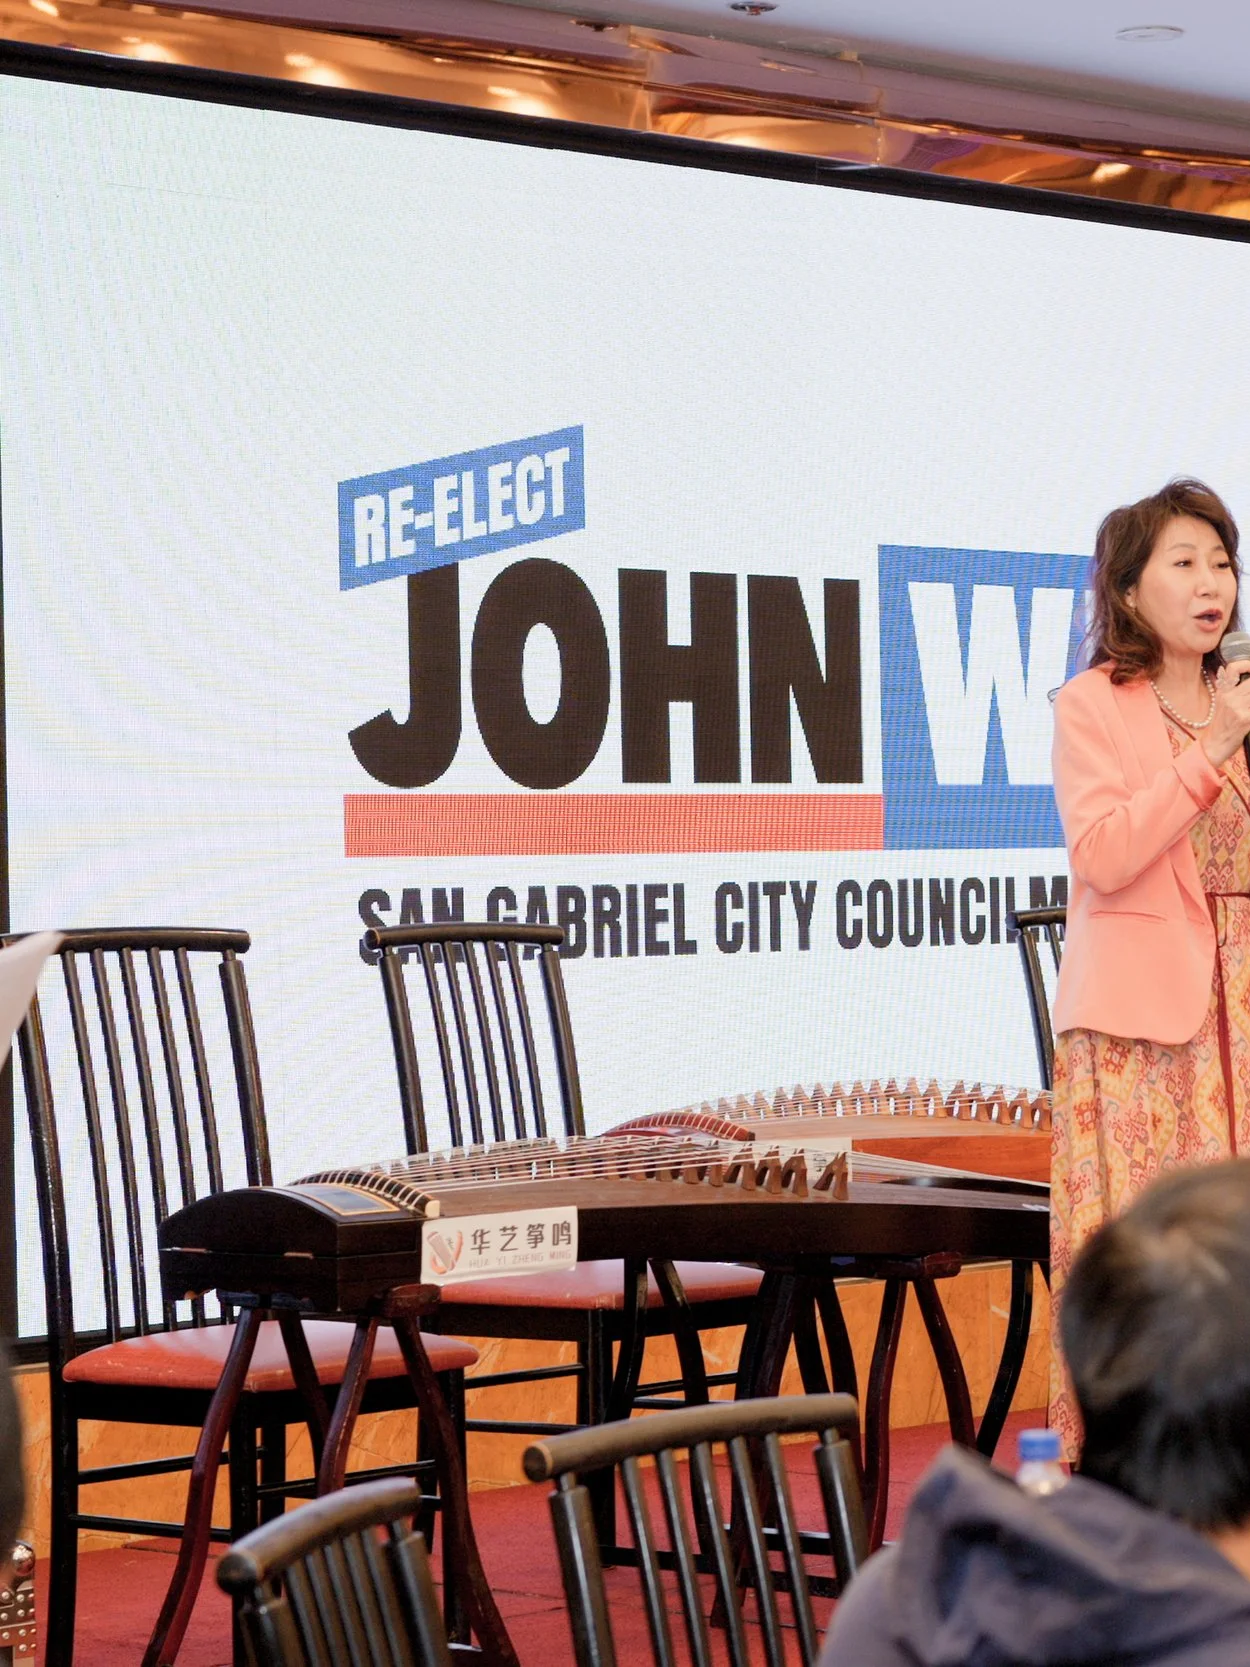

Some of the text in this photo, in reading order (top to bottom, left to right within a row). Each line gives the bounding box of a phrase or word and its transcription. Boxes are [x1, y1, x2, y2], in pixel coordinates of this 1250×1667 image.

[354, 447, 571, 568] RE-ELECT
[347, 557, 864, 790] JOHN
[907, 581, 1096, 785] W
[358, 887, 464, 966] SAN
[486, 883, 697, 961] GABRIEL
[715, 880, 818, 954] CITY
[470, 1220, 571, 1255] 华艺筝鸣
[512, 1253, 544, 1265] ZHENG
